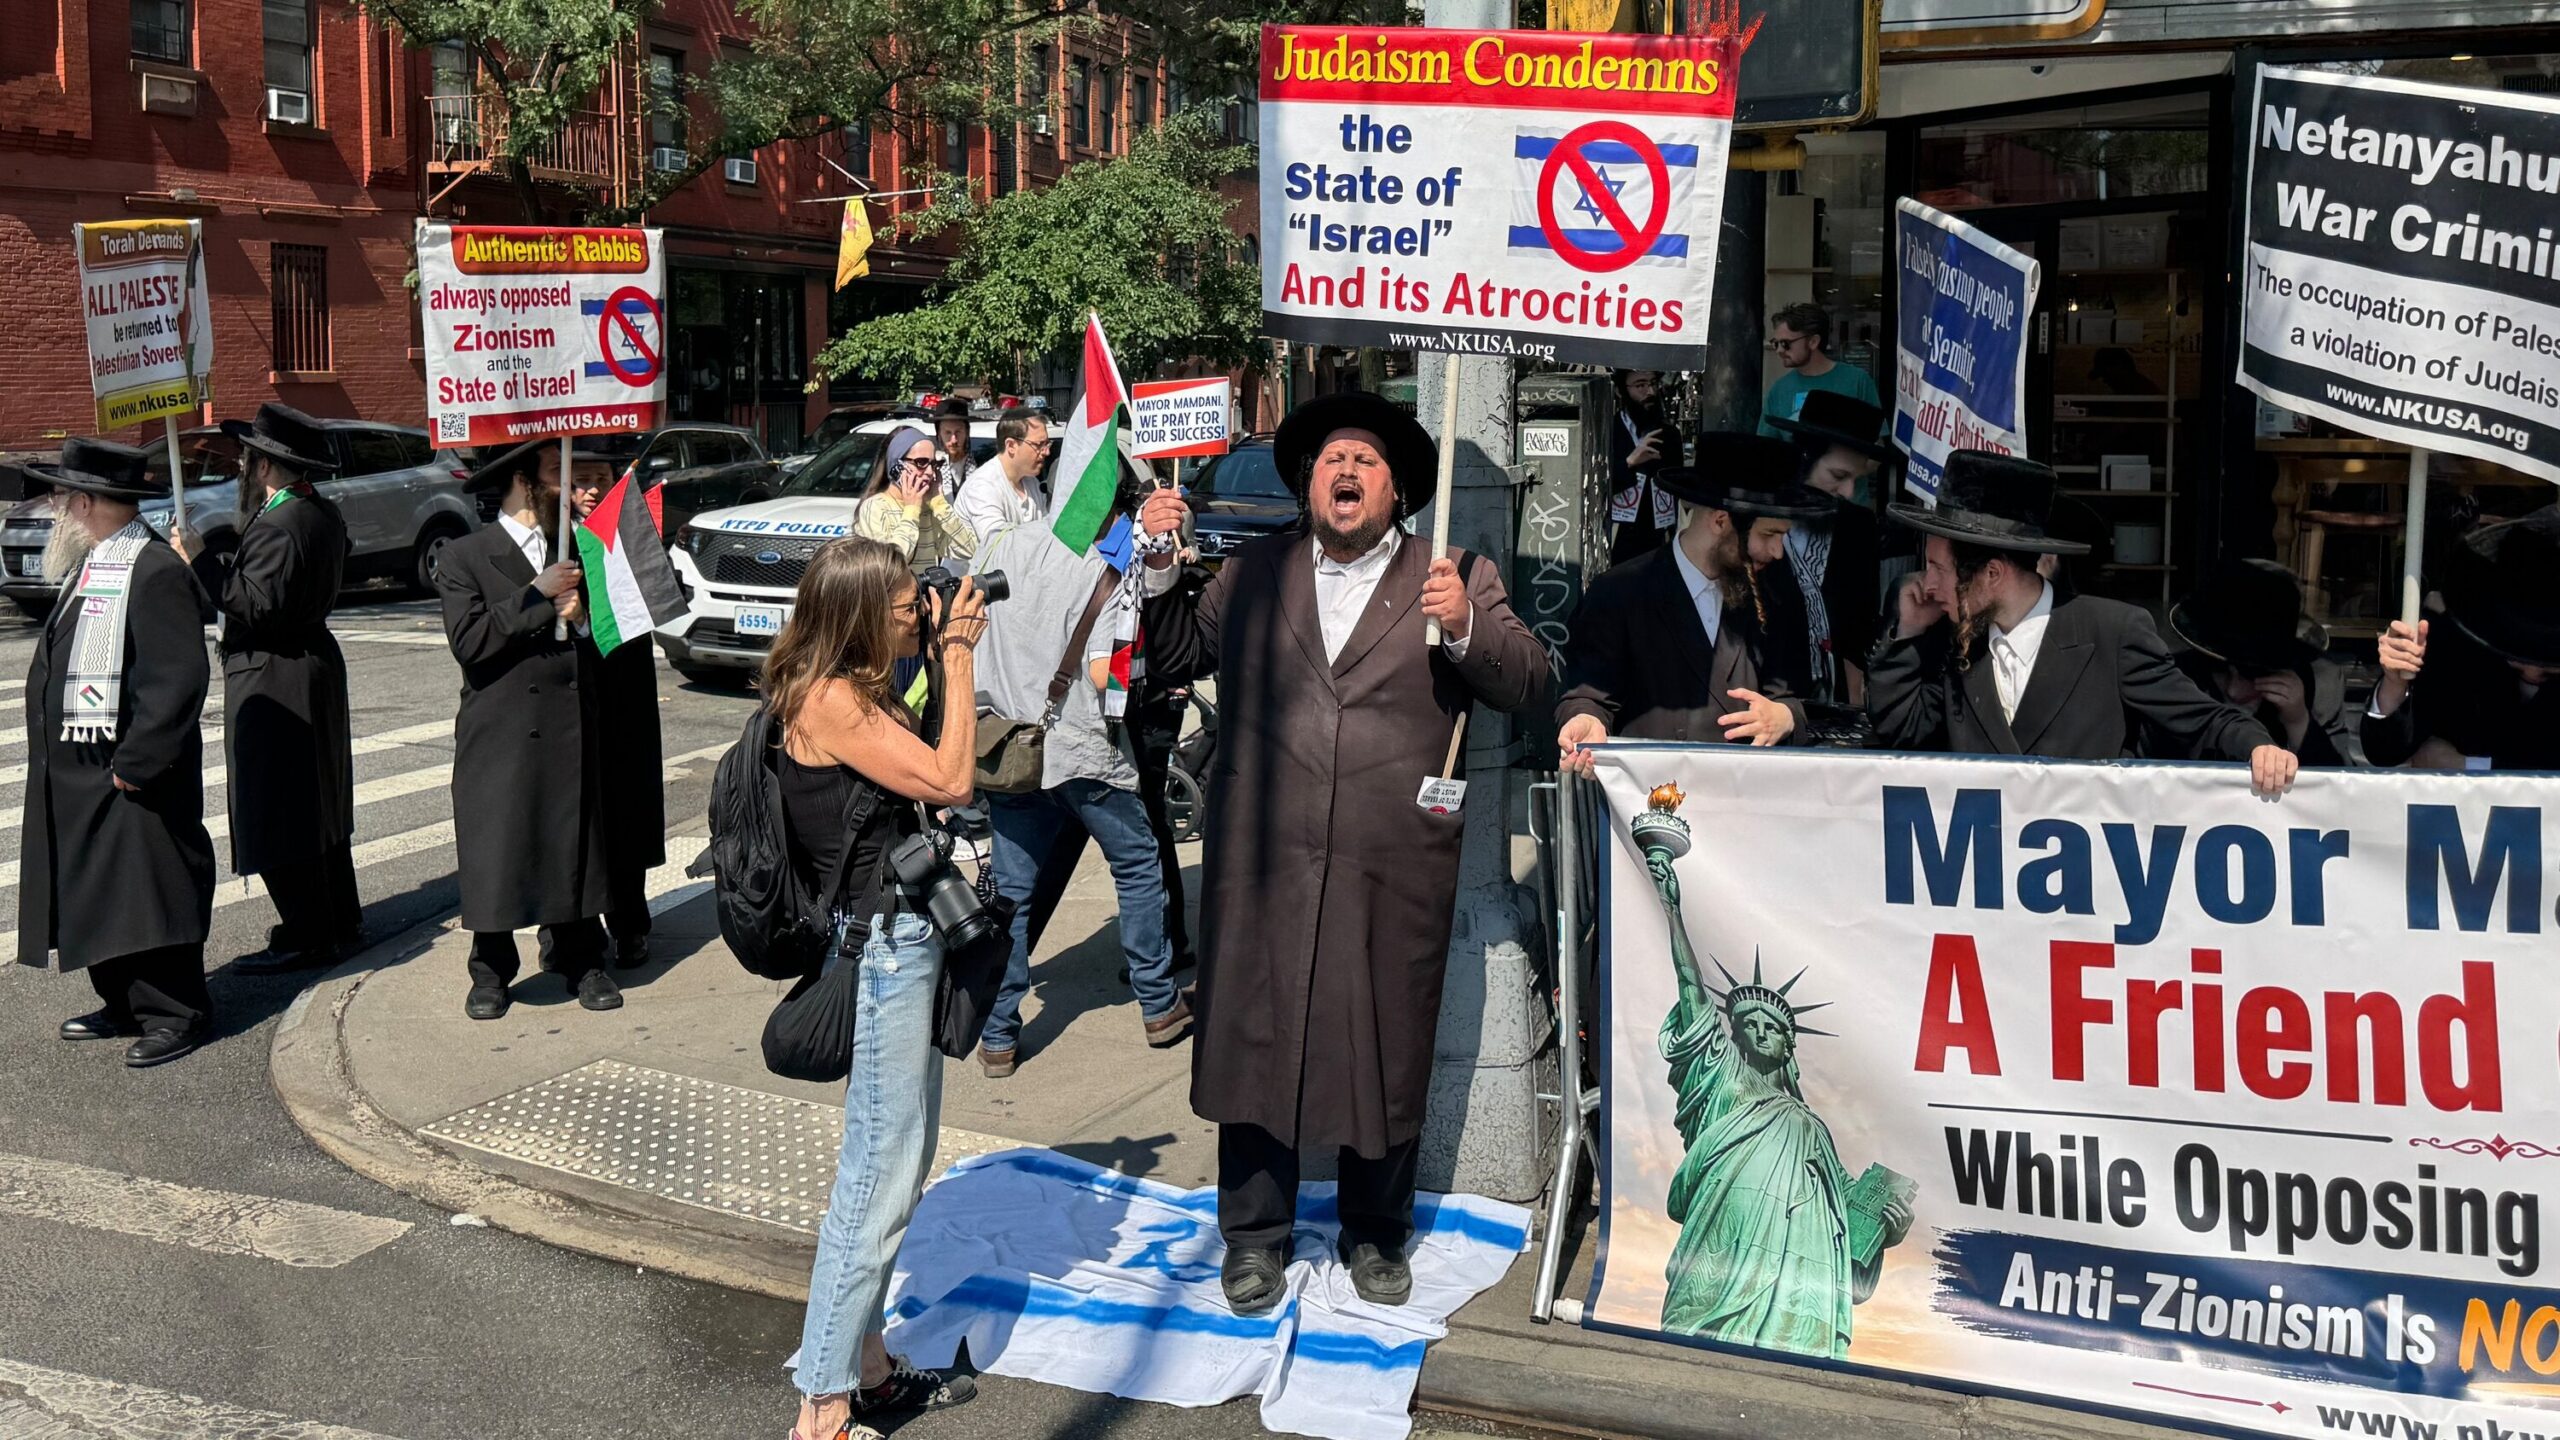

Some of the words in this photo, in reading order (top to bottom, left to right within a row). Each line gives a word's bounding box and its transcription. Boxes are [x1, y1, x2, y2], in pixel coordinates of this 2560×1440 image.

[1273, 34, 1451, 85] Judaism
[1464, 37, 1719, 95] Condemns
[1340, 114, 1412, 154] the
[2261, 104, 2560, 194] Netanyahu
[1285, 162, 1404, 204] State
[1416, 166, 1463, 207] of
[2276, 182, 2377, 243] War
[100, 232, 135, 256] Torah
[463, 233, 567, 263] Authentic
[572, 234, 642, 264] Rabbis
[88, 284, 118, 318] ALL
[430, 282, 497, 316] always
[500, 280, 571, 314] opposed
[1281, 262, 1365, 308] And
[1379, 267, 1430, 313] its
[1443, 272, 1684, 333] Atrocities
[1972, 280, 2014, 331] people
[2256, 265, 2293, 297] The
[2298, 280, 2446, 332] occupation
[2454, 311, 2487, 338] of
[113, 323, 124, 343] be
[125, 314, 164, 340] returned
[165, 314, 178, 333] to
[453, 323, 556, 353] Zionism
[486, 355, 510, 372] and
[512, 354, 532, 370] the
[1388, 332, 1556, 362] www.NKUSA.org
[2290, 326, 2305, 346] a
[2312, 329, 2417, 375] violation
[2425, 354, 2462, 383] of
[2464, 362, 2560, 409] Judais
[438, 376, 497, 405] State
[503, 371, 519, 401] of
[523, 369, 576, 399] Israel
[506, 411, 638, 436] www.NKUSA.org
[1136, 399, 1171, 412] MAYOR
[1140, 414, 1158, 429] WE
[1161, 412, 1191, 427] PRAY
[1195, 411, 1220, 425] FOR
[2326, 383, 2530, 452] www.NKUSA.org
[1135, 430, 1166, 444] YOUR
[1170, 425, 1225, 442] SUCCESS!
[720, 519, 770, 531] NYPD
[774, 522, 848, 535] POLICE
[738, 614, 768, 628] 4559
[1882, 784, 2350, 945] Mayor
[1914, 932, 2002, 1077] A
[2049, 939, 2503, 1113] Friend
[1943, 1126, 2146, 1229] While
[2172, 1142, 2540, 1277] Opposing
[1999, 1251, 2368, 1359] Anti-Zionism
[2385, 1293, 2436, 1367] Is
